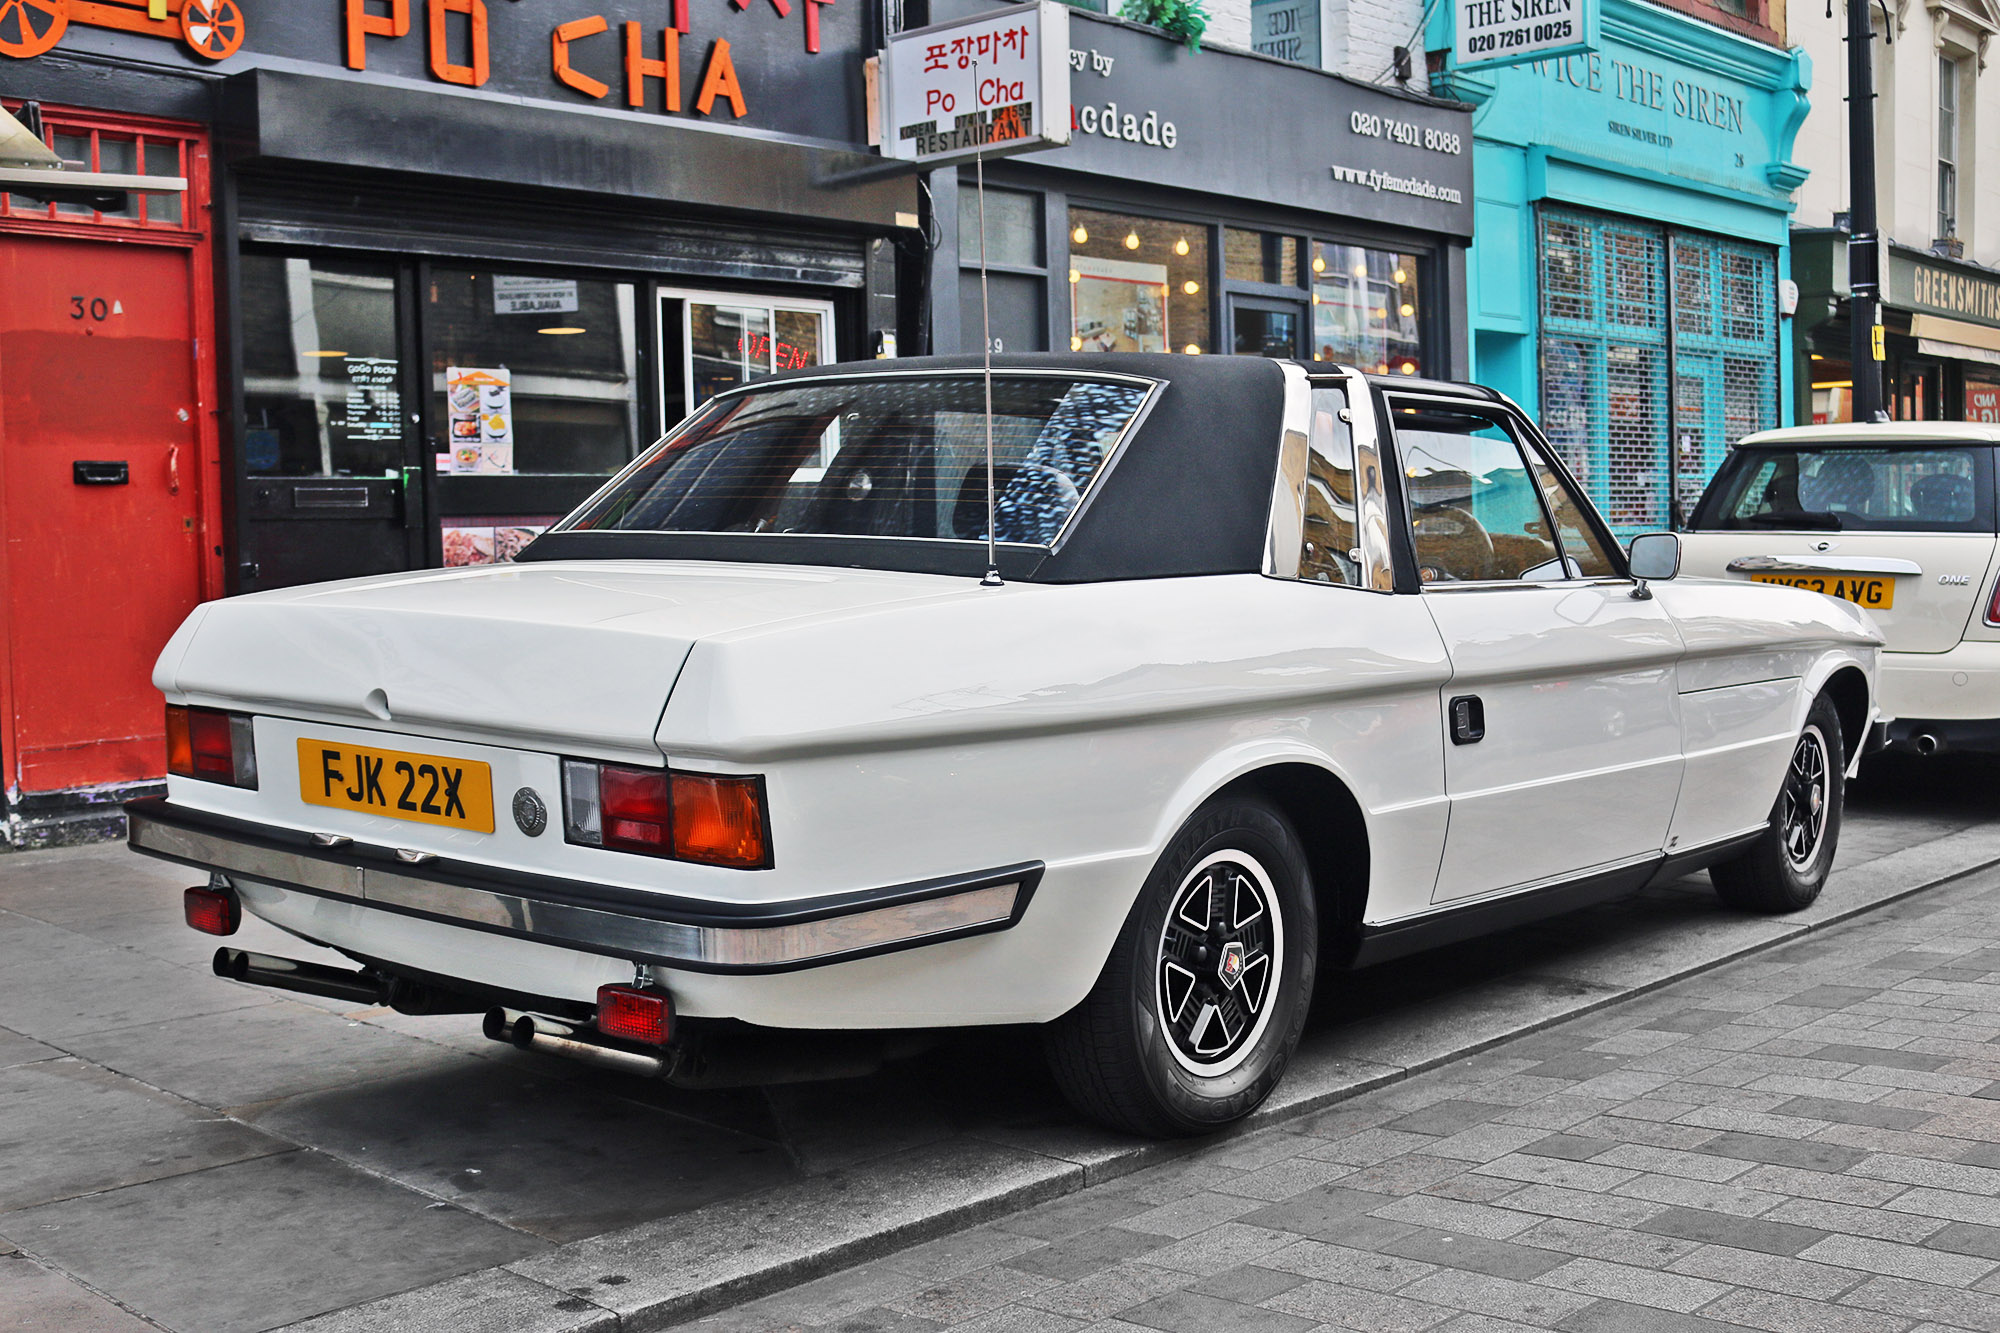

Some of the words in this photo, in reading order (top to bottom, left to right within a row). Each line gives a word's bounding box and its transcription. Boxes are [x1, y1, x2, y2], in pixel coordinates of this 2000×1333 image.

[1465, 0, 1505, 29] THE
[924, 25, 1030, 73] 포장마차
[1468, 34, 1496, 54] 020
[1498, 27, 1531, 49] 7261
[1534, 20, 1572, 42] 0025
[346, 0, 490, 88] PO
[552, 15, 749, 119] CHA
[1091, 49, 1114, 77] by
[926, 89, 956, 116] Po
[979, 77, 1024, 106] Cha
[1611, 59, 1665, 112] THE
[1673, 79, 1744, 135] SIREN
[901, 121, 937, 140] KOREAN
[917, 118, 1030, 156] RESTAURANT
[1070, 102, 1178, 149] cdade
[1351, 110, 1382, 138] 020
[1384, 118, 1421, 147] 7401
[1424, 127, 1461, 155] 8088
[1608, 120, 1631, 137] SIREN
[1632, 128, 1657, 144] SILVER
[1658, 134, 1673, 149] LTD
[1331, 165, 1462, 204] www.fyfemcdade.com
[1914, 265, 2000, 321] GREENSMITHS
[737, 331, 809, 369] OPEN
[1833, 579, 1884, 604] AVG
[1938, 574, 1970, 586] ONE
[322, 749, 387, 807] FJK
[395, 760, 466, 820] 22X
